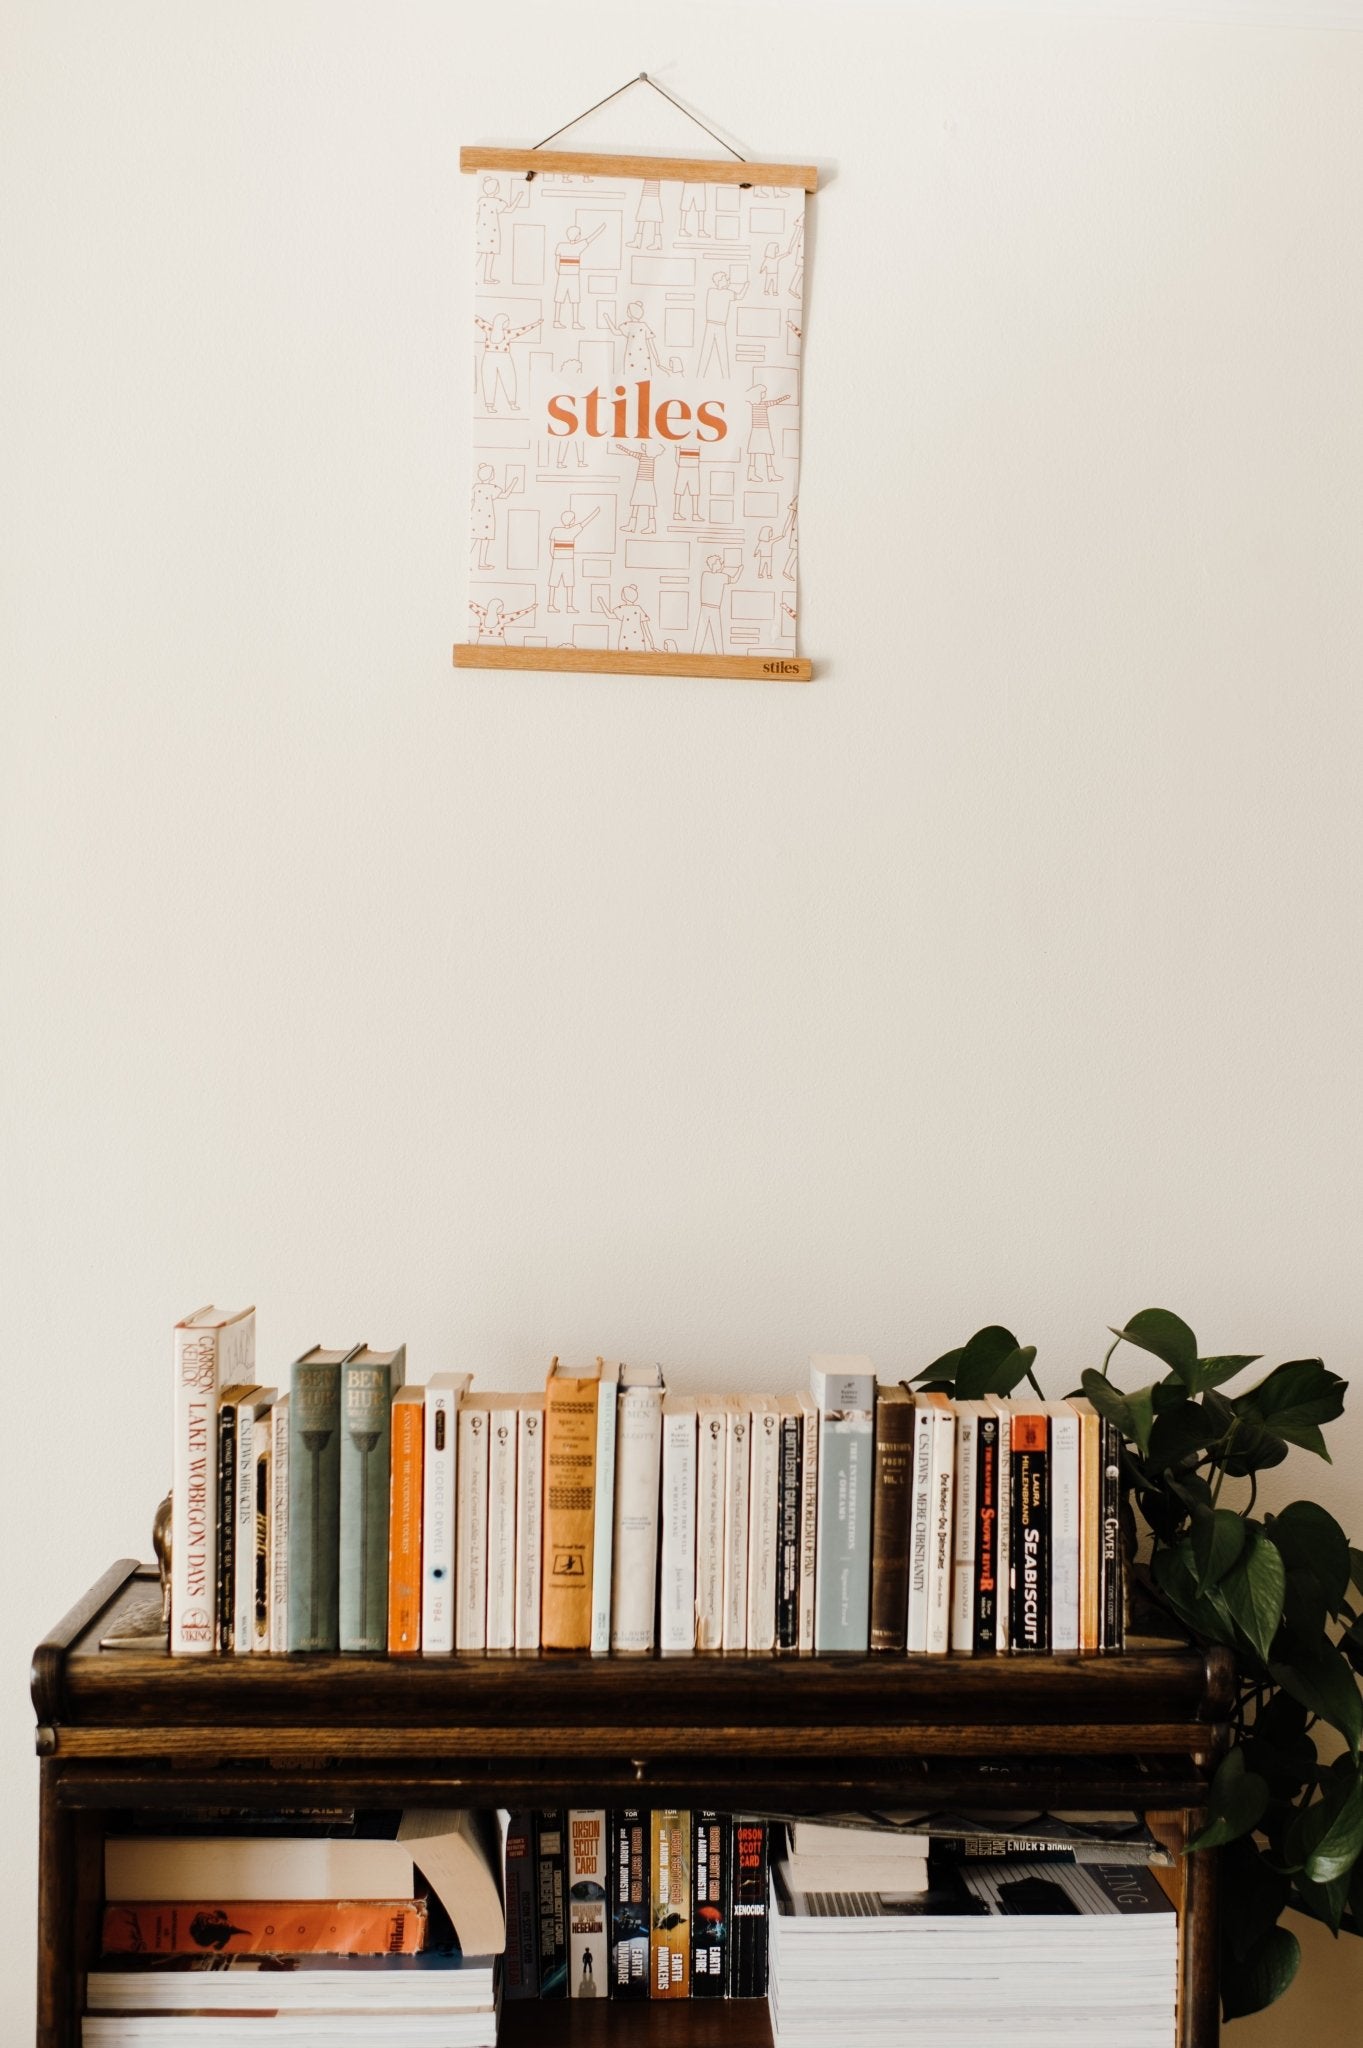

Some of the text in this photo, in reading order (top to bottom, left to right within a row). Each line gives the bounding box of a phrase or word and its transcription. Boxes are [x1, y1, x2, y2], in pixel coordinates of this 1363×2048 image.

[547, 380, 728, 442] stiles
[762, 661, 799, 674] stiles
[182, 1343, 199, 1387] KEILLOR
[199, 1336, 215, 1394] GARRISON
[347, 1370, 385, 1388] BEN
[347, 1389, 386, 1408] HUR
[403, 1460, 411, 1475] THE
[785, 1431, 797, 1488] BATTLESTAR
[434, 1460, 445, 1507] GEORGE
[805, 1472, 815, 1490] THE
[940, 1473, 950, 1486] One
[1001, 1473, 1010, 1488] THE
[1021, 1455, 1030, 1525] HILLENBRAND
[188, 1403, 207, 1596] LAKE WOBEGON DAYS
[224, 1438, 232, 1567] VOYAGE TO THE BOTTOM OF THE SEA
[240, 1473, 252, 1525] MIRACLES
[402, 1476, 410, 1521] ACCIDENTAL
[681, 1500, 688, 1510] OF
[838, 1478, 847, 1521] DREAMS
[848, 1441, 858, 1550] THE INTERPRETATION
[916, 1493, 928, 1520] MERE
[961, 1447, 971, 1558] THE CATCHER IN THE RYE
[785, 1489, 797, 1541] GALACTICA
[805, 1492, 815, 1539] PROBLEM
[981, 1508, 996, 1550] SNOWY
[433, 1510, 443, 1554] ORWELL
[805, 1540, 815, 1551] OF
[1104, 1518, 1119, 1560] GIVER
[805, 1555, 815, 1577] PAIN
[913, 1521, 927, 1593] CHRISTIANITY
[980, 1553, 994, 1591] RIVER
[1024, 1529, 1040, 1643] SEABISCUIT
[434, 1595, 443, 1623] 1984
[840, 1603, 849, 1627] Freud
[181, 1630, 212, 1641] VIKING
[572, 1820, 600, 1839] ORSON
[737, 1828, 763, 1840] ORSON
[573, 1839, 599, 1857] SCOTT
[739, 1841, 761, 1854] SCOTT
[965, 1839, 978, 1856] ORSO
[979, 1839, 992, 1856] SCOT
[993, 1840, 1006, 1856] CAR
[1007, 1840, 1045, 1851] ENDERS
[575, 1857, 597, 1875] CARD
[620, 1828, 629, 1902] and AARON JOHNSTON
[632, 1826, 643, 1904] ORSON SCOTT CARD
[659, 1829, 669, 1903] and AARON JOHNSTON
[671, 1829, 682, 1905] ORSON SCOTT CARD
[697, 1827, 707, 1901] and AARON JOHNSTON
[709, 1826, 720, 1901] ORSON SCOTT CARD
[739, 1855, 760, 1867] CARD
[554, 1897, 564, 1921] SCOTT
[734, 1904, 765, 1916] XENOCIDE
[522, 1918, 532, 1942] SCOTT
[540, 1918, 554, 1956] GAME
[554, 1923, 564, 1945] CARD
[572, 1922, 603, 1934] HEGEMON
[522, 1943, 532, 1964] CARD
[618, 1941, 629, 1985] UNAWARE
[632, 1948, 643, 1976] EARTH
[671, 1953, 683, 1982] EARTH
[695, 1948, 707, 1973] AFIRE
[709, 1946, 721, 1975] EARTH
[657, 1946, 669, 1990] AWAKENS
